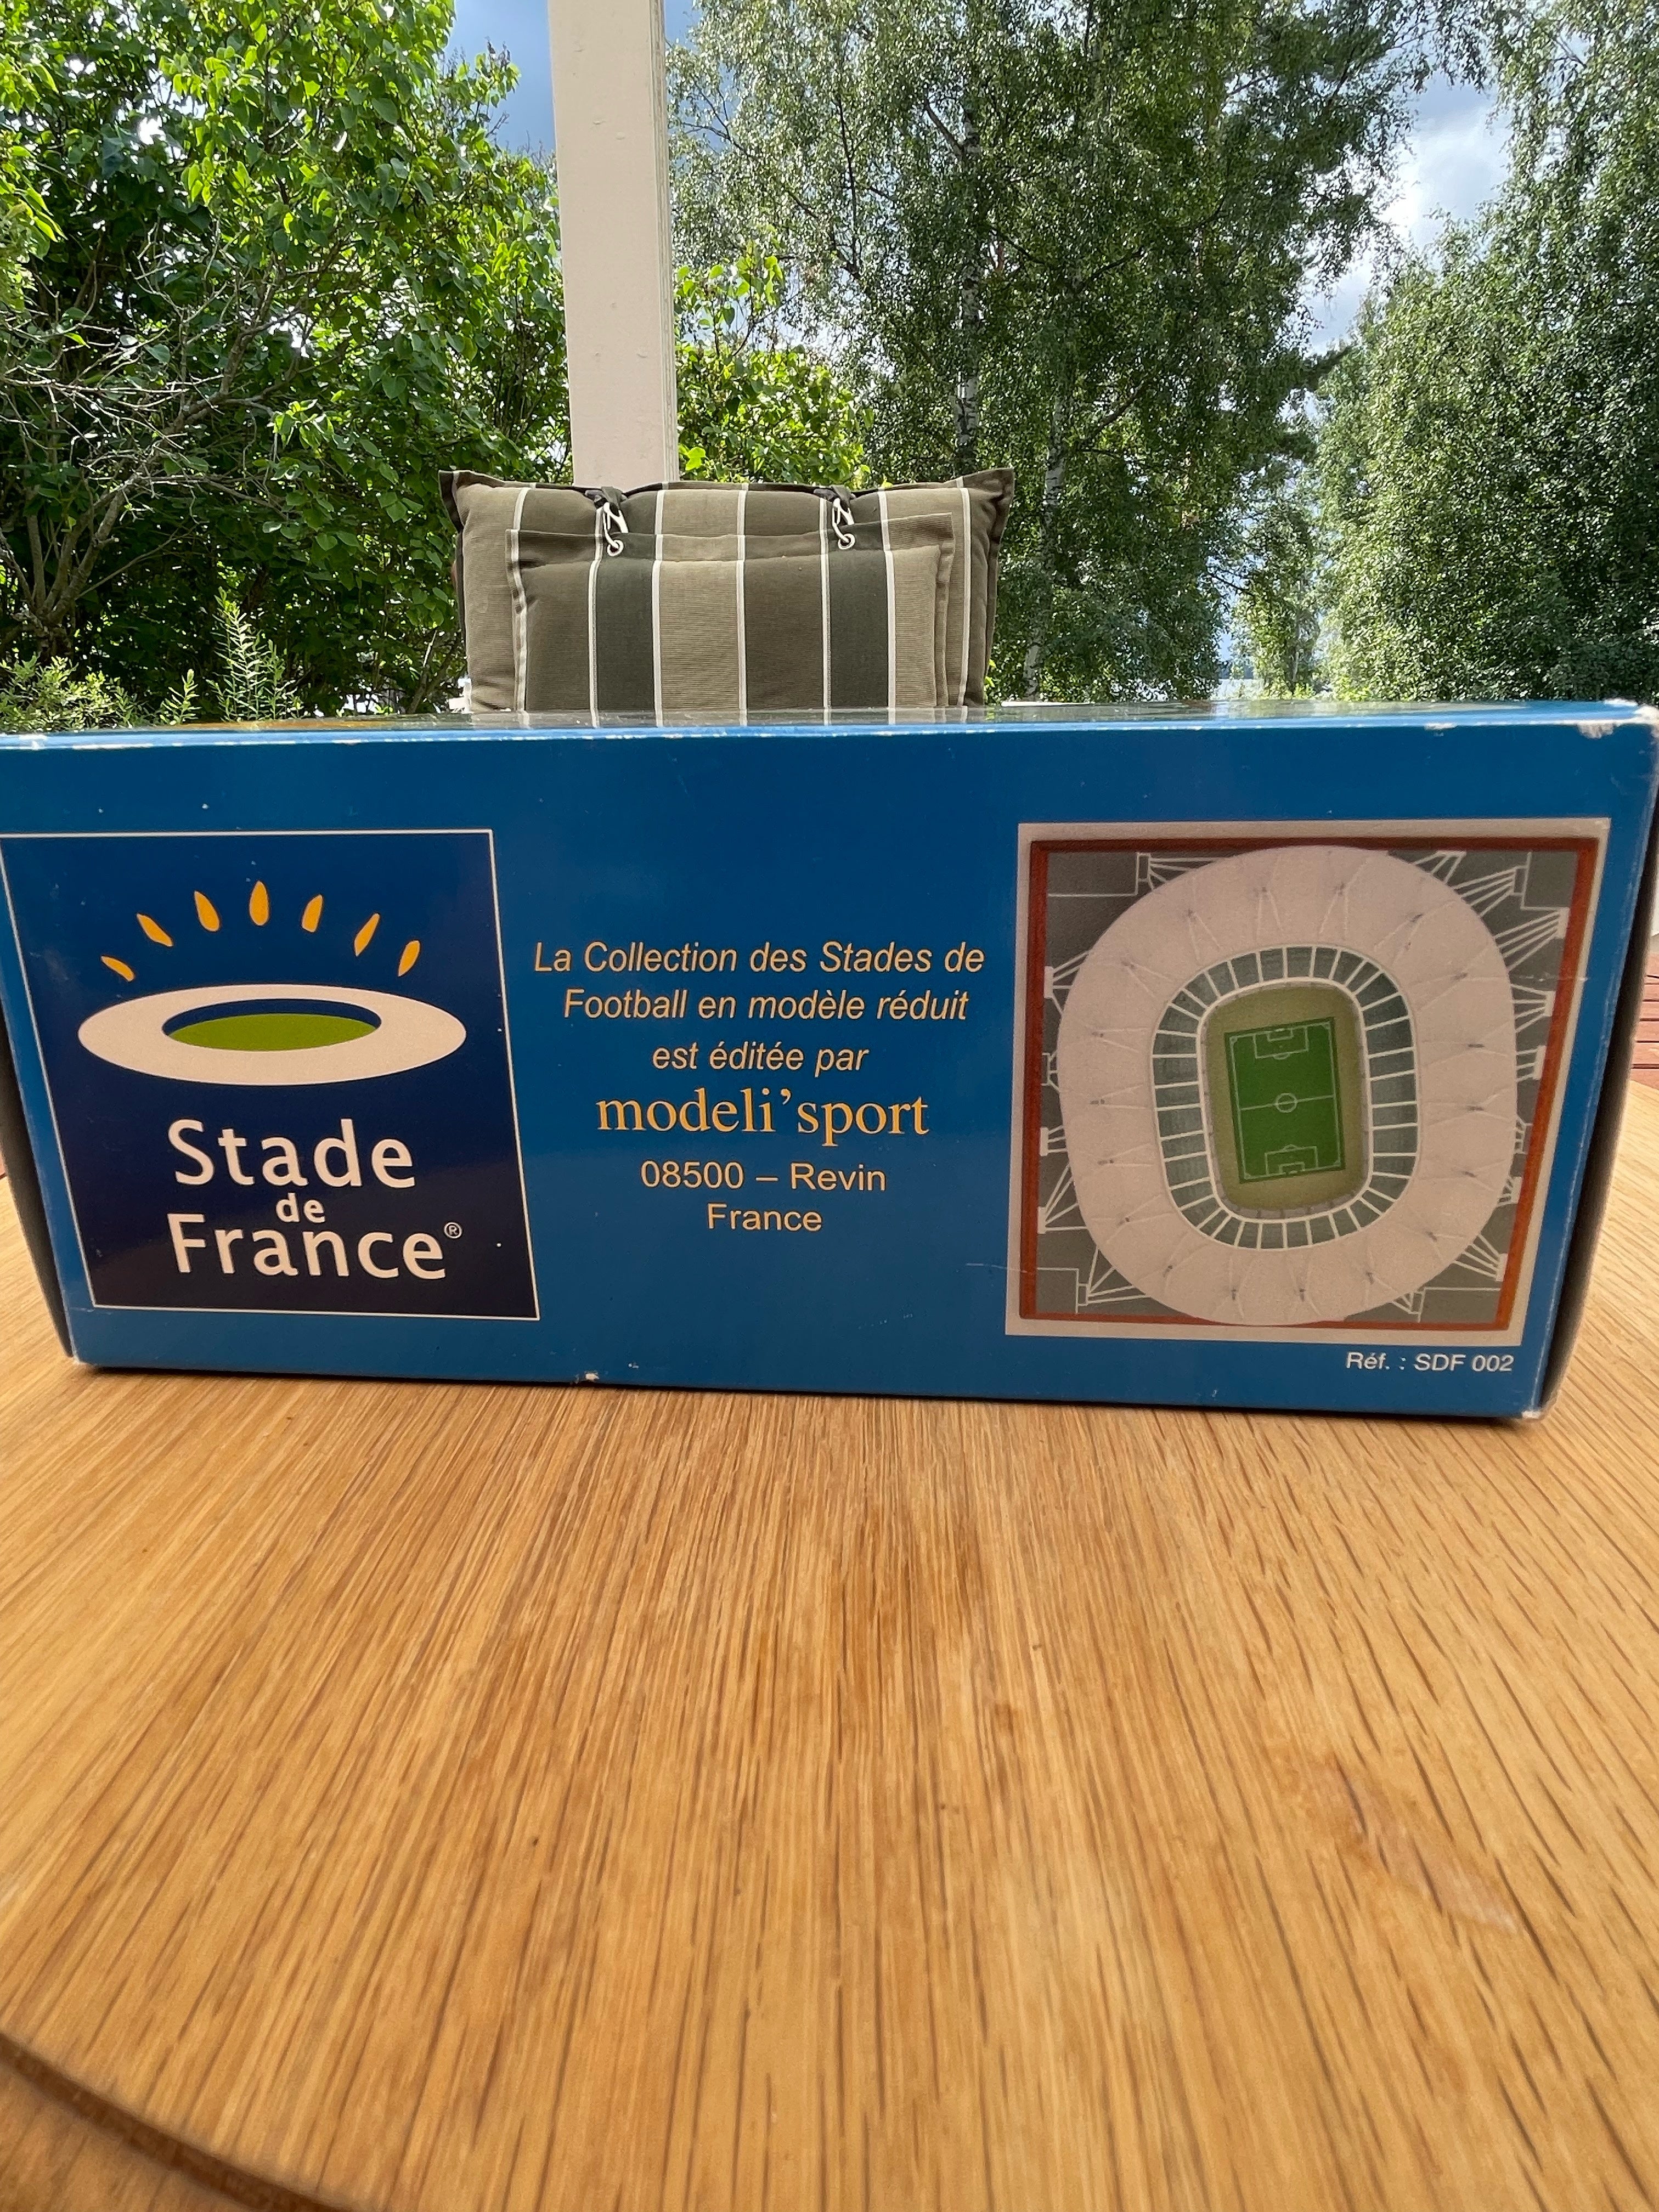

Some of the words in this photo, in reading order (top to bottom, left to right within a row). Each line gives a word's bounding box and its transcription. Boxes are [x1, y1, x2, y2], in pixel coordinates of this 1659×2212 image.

[534, 942, 571, 972] La
[584, 941, 737, 972] Collection
[750, 941, 807, 972] des
[820, 941, 933, 972] Stades
[945, 941, 984, 972] de
[564, 989, 687, 1018] Football
[698, 996, 736, 1019] en
[748, 990, 865, 1019] modèle
[877, 990, 969, 1020] réduit
[652, 1042, 699, 1069] est
[709, 1041, 804, 1070] éditée
[814, 1049, 870, 1077] par
[168, 1118, 415, 1188] Stade
[641, 1160, 744, 1189] 08500
[791, 1163, 885, 1191] Revin
[275, 1192, 325, 1223] de
[708, 1203, 822, 1231] France
[1346, 1352, 1390, 1370] Réf.
[1413, 1353, 1466, 1371] SDF
[1471, 1355, 1514, 1372] 002
